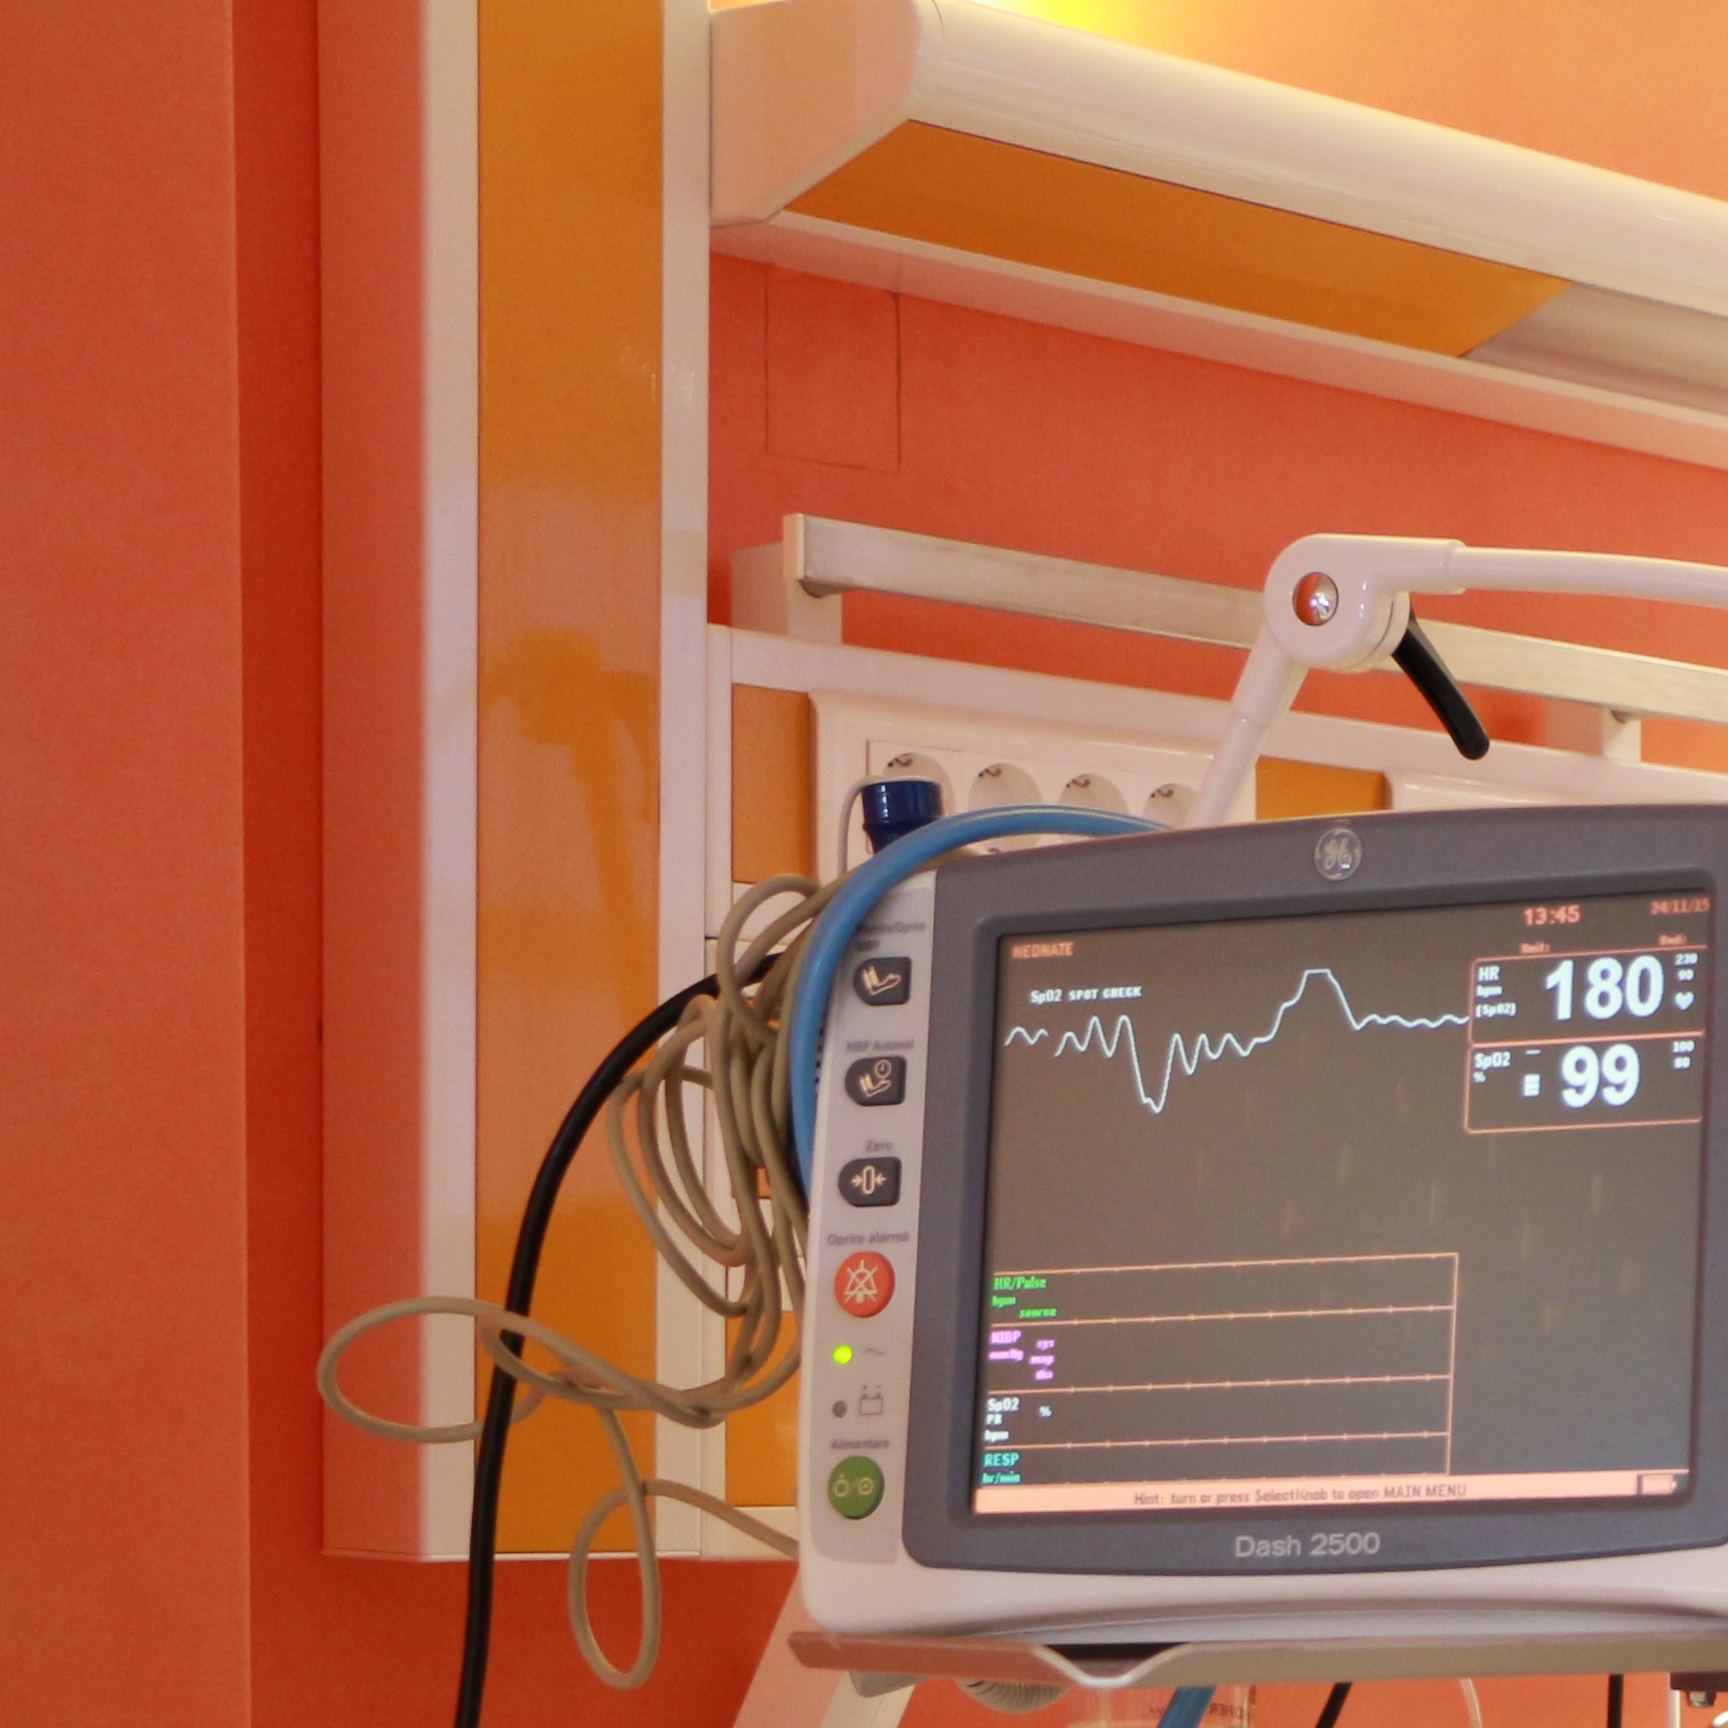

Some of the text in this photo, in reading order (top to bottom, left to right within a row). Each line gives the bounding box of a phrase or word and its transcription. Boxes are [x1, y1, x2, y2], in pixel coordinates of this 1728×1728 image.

[1524, 904, 1581, 926] 13:45
[1012, 942, 1075, 959] NEONATE
[1478, 966, 1500, 981] HR
[1068, 988, 1099, 1001] SPOT
[1102, 985, 1142, 999] CHECK
[1546, 955, 1664, 1020] 180
[1561, 1044, 1640, 1108] 99
[866, 1141, 893, 1152] Zero
[993, 1276, 1047, 1290] HR/Pulse
[984, 1452, 1020, 1467] RESP
[1171, 1492, 1197, 1504] turn
[1201, 1493, 1213, 1503] or
[1216, 1491, 1250, 1506] press
[1332, 1489, 1344, 1500] to
[1348, 1488, 1379, 1502] open
[1384, 1486, 1421, 1499] MAIN
[1425, 1484, 1467, 1498] MENU
[1235, 1532, 1381, 1557] Dash 2500
